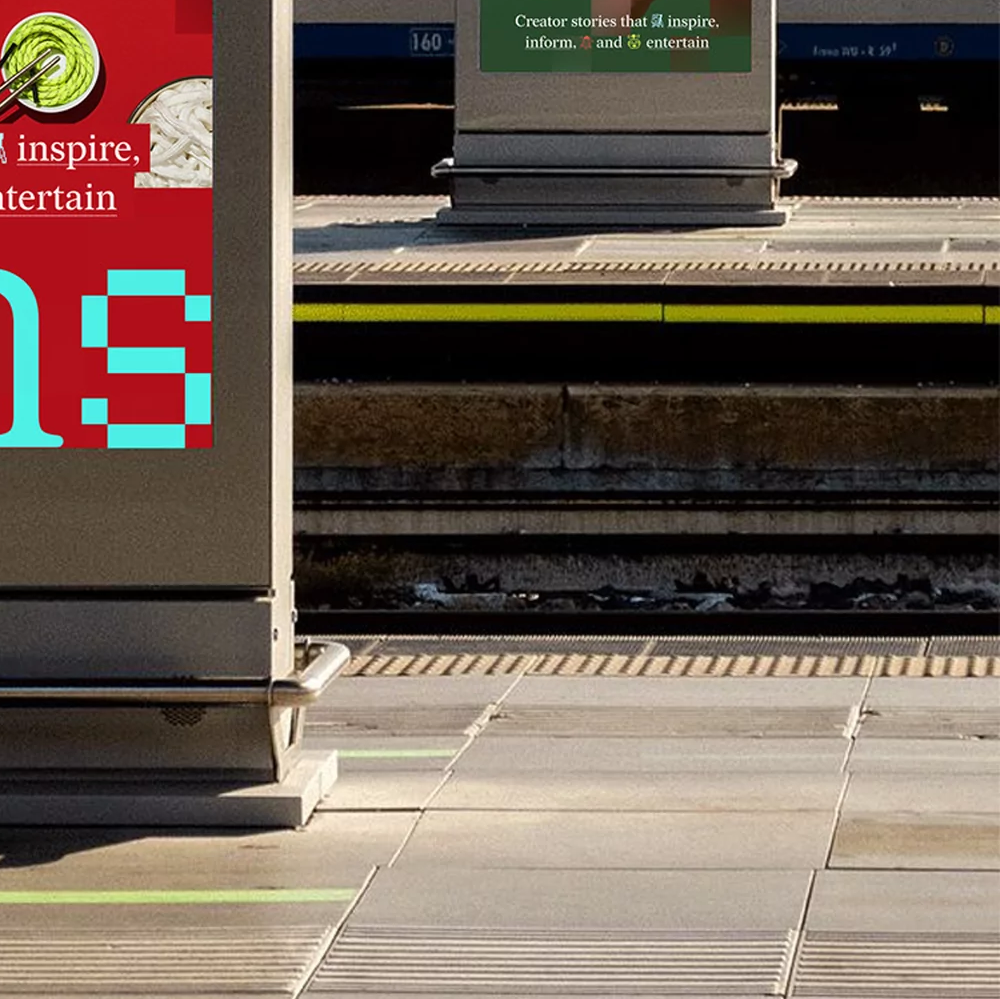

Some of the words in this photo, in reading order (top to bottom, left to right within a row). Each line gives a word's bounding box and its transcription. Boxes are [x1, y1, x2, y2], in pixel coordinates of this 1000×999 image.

[515, 14, 568, 28] Creator
[571, 14, 617, 28] stories
[620, 14, 647, 28] that
[667, 14, 720, 31] inspire,
[412, 32, 442, 52] 160
[525, 35, 577, 50] inform,
[596, 35, 622, 48] and
[646, 35, 709, 49] entertain
[17, 132, 141, 169] inspire,
